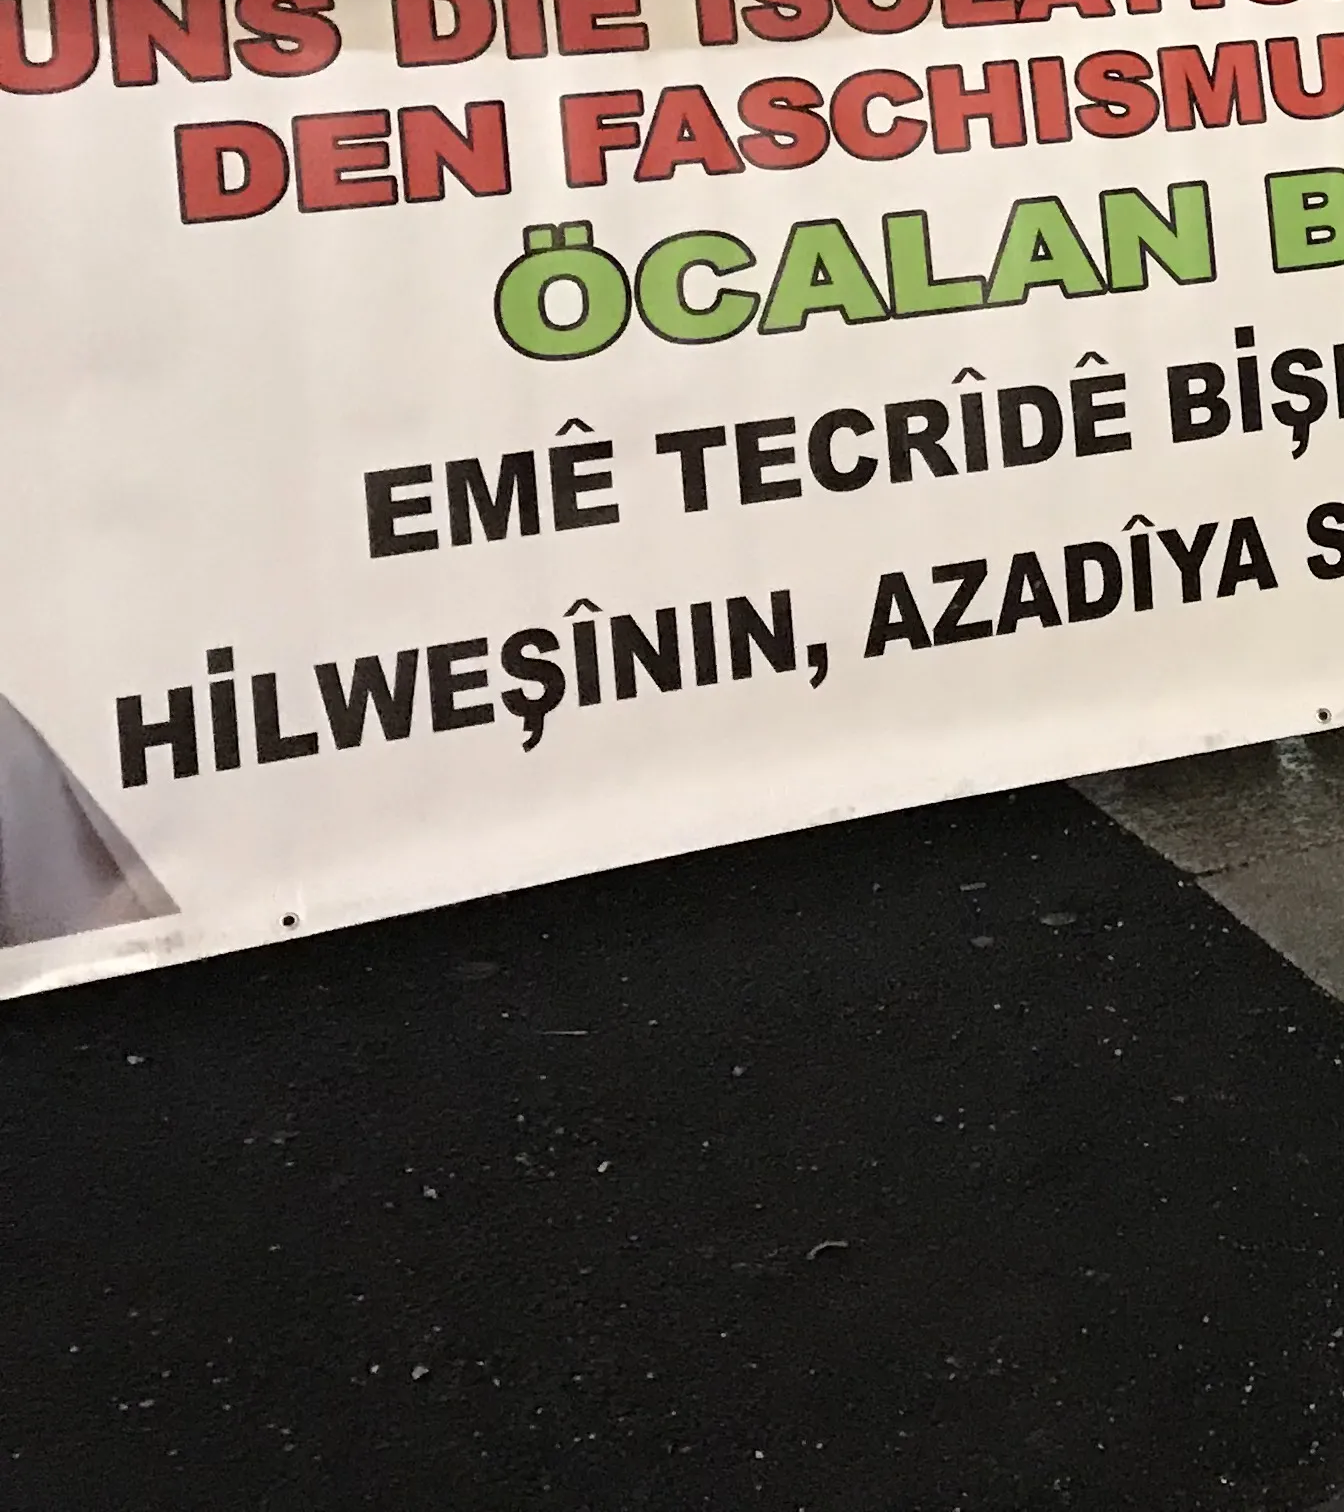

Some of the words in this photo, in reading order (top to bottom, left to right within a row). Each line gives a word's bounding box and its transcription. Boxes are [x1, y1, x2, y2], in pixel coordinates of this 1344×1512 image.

[173, 100, 512, 225] DEN
[493, 180, 1214, 361] ÖCALAN
[364, 418, 621, 559] EMÊ
[654, 352, 1132, 513] TECRÎDÊ
[863, 514, 1279, 659] AZADÎYA
